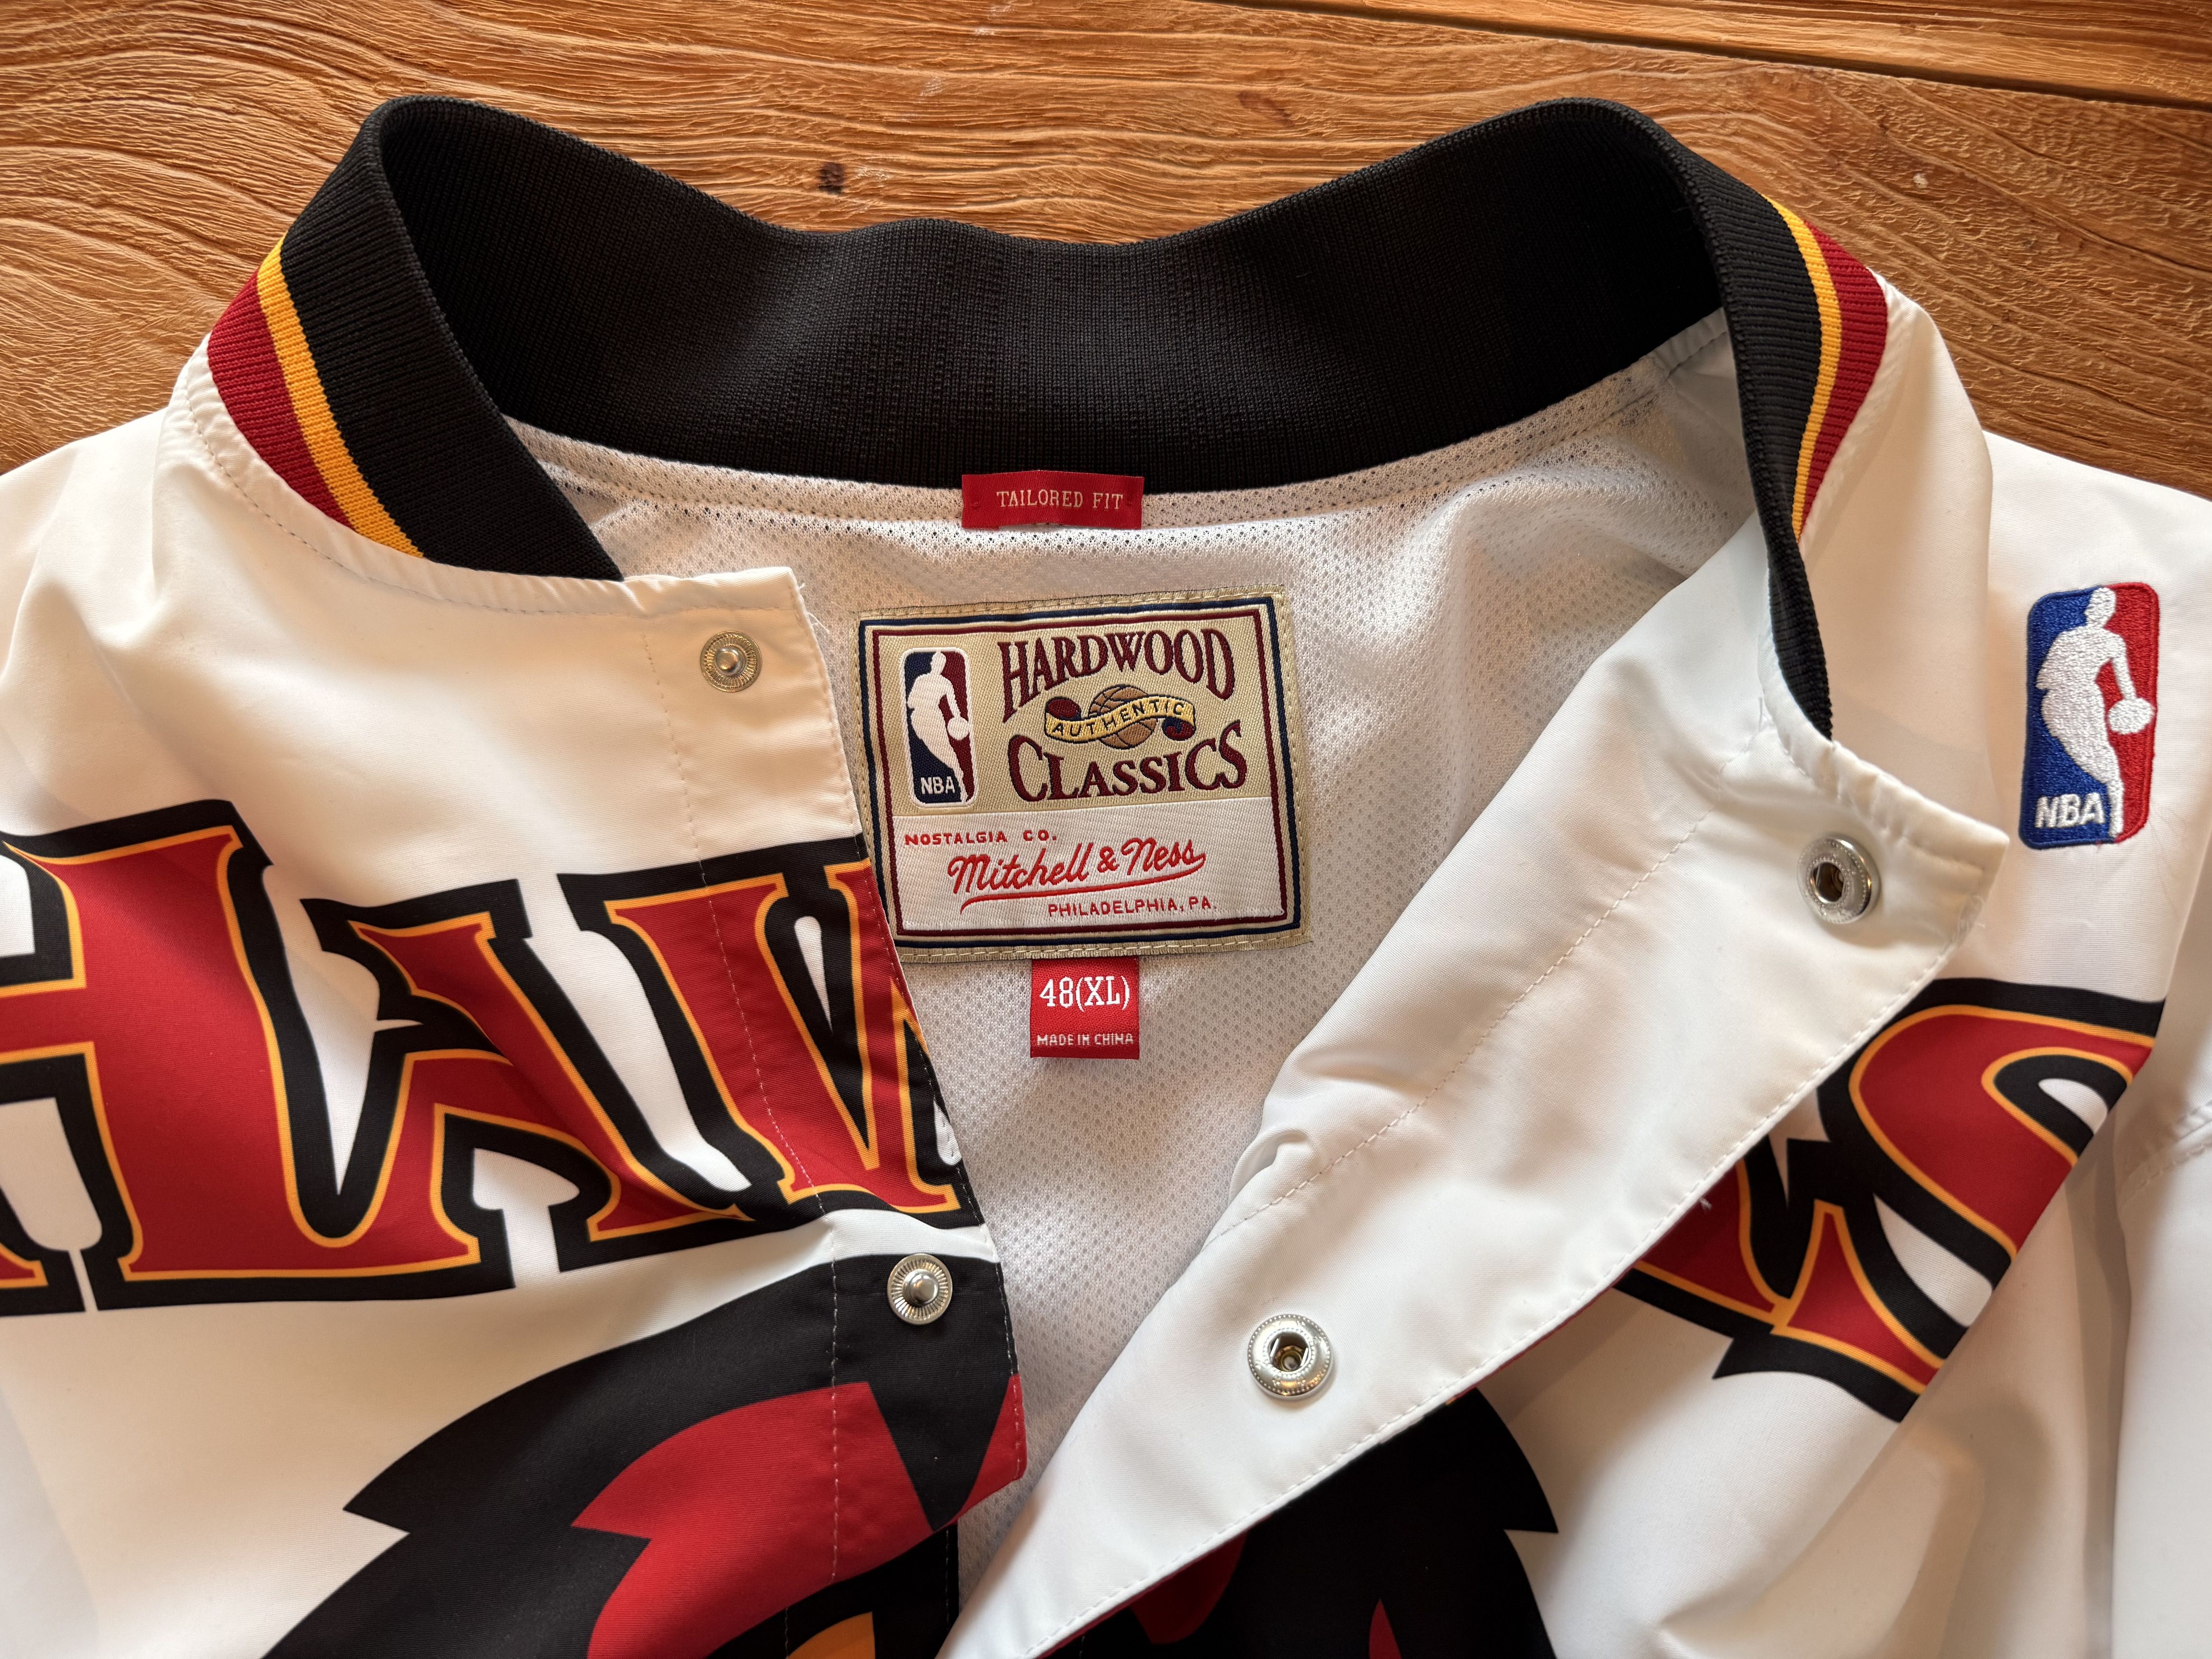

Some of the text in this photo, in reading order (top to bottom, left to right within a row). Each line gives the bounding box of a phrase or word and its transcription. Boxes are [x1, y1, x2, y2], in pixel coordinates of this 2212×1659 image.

[996, 489, 1124, 510] TAILORED FIT
[997, 629, 1236, 723] HARDWOOD
[1052, 701, 1185, 738] AUTHENTIC
[1008, 720, 1247, 802] CLASSICS
[920, 775, 956, 795] NBA
[2034, 792, 2106, 829] NBA
[904, 830, 1057, 846] NOSTALGIA CO.
[947, 837, 1206, 894] Mitchell & Ness
[1188, 895, 1218, 910] PA.
[1039, 975, 1130, 1012] 48(XL)
[1036, 1032, 1135, 1046] MADE IN CHINA
